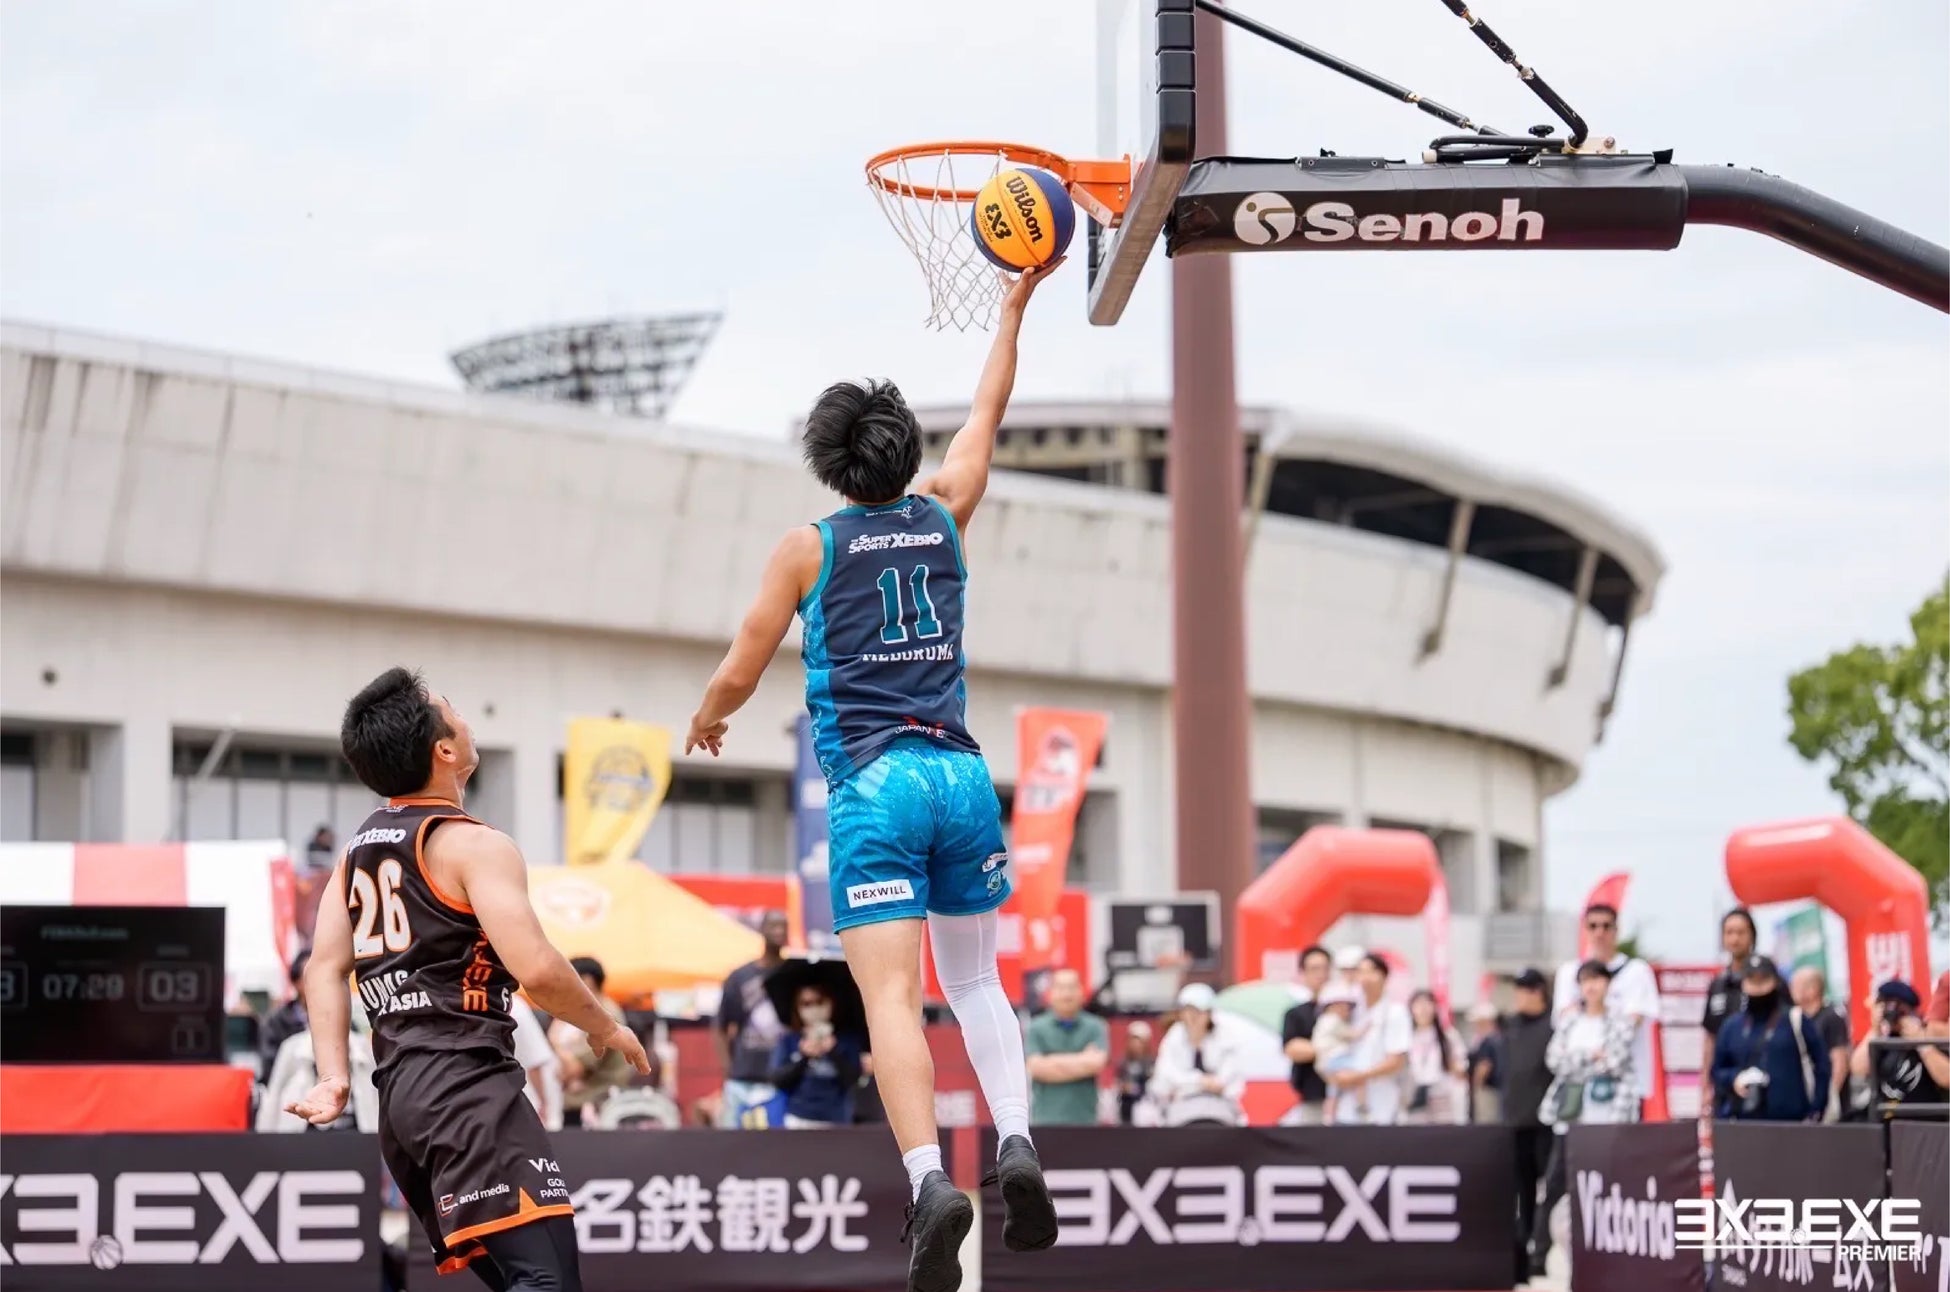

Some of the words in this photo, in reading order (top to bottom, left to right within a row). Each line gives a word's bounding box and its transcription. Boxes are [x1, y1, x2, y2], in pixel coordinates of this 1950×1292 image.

[1006, 176, 1043, 243] Wilson
[1303, 198, 1544, 241] Senoh
[890, 532, 944, 548] XEBIO
[877, 565, 943, 644] 11
[895, 725, 931, 735] JAPAN
[349, 858, 412, 960] 26
[853, 886, 907, 901] NEXWILL
[151, 970, 199, 1002] 03
[389, 991, 432, 1013] ASIA
[460, 1190, 479, 1205] and
[480, 1183, 510, 1199] media
[570, 1173, 870, 1253] 名鉄観光
[1576, 1168, 1676, 1260] Victoria
